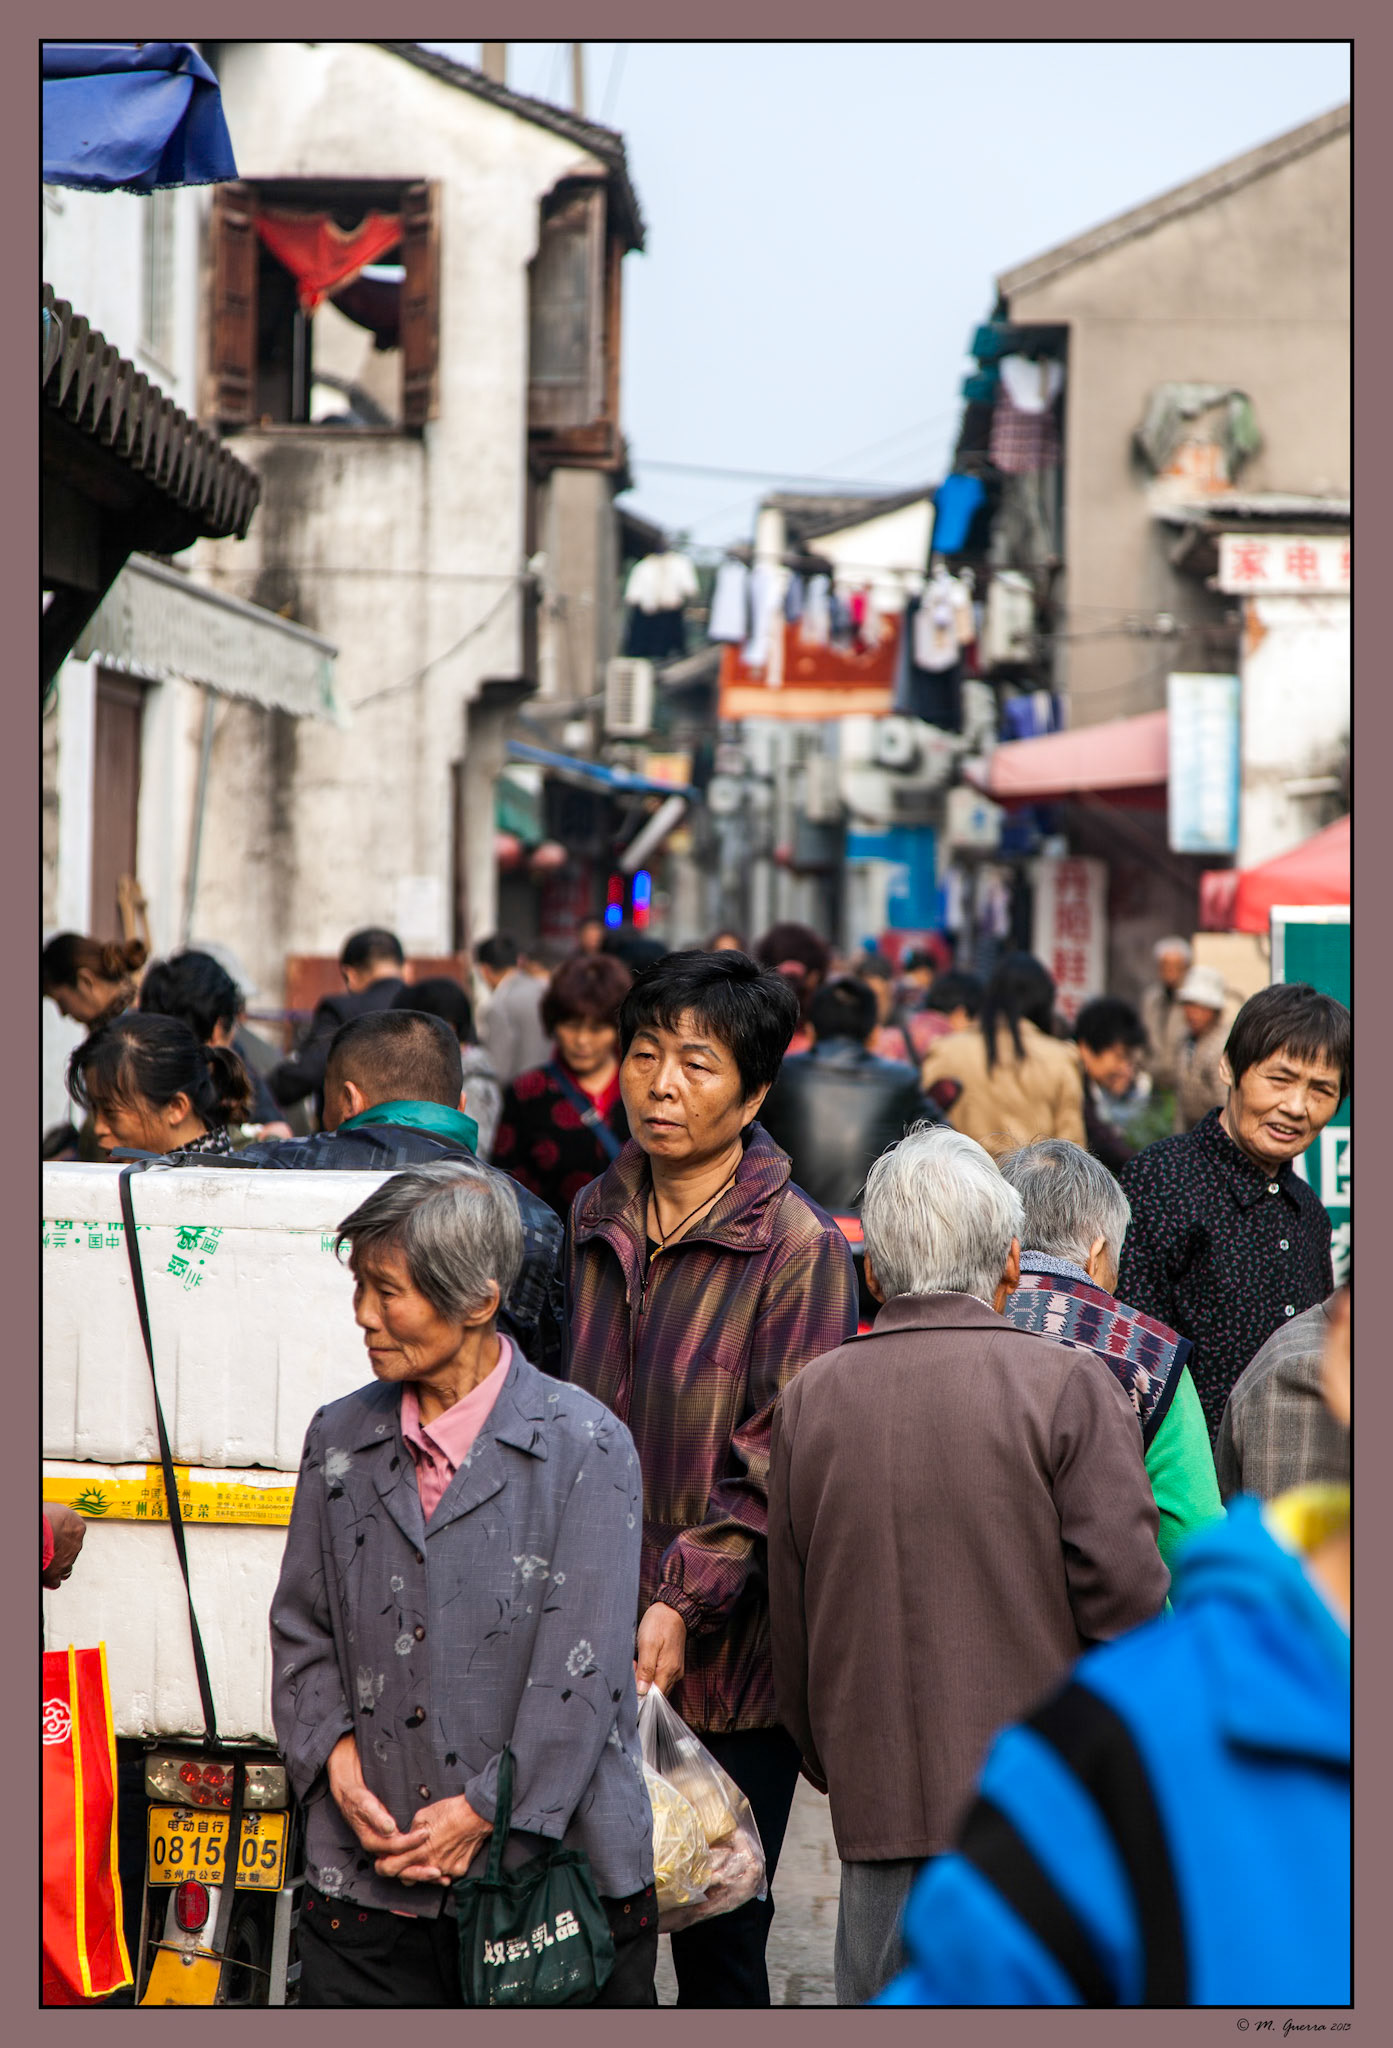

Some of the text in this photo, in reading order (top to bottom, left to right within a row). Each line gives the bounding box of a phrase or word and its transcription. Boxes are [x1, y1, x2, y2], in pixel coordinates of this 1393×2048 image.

[1231, 540, 1349, 582] 家电
[184, 1227, 223, 1291] 中国·兰
[121, 1501, 209, 1518] 兰州高夏菜
[168, 1820, 225, 1833] 电动自行
[154, 1836, 277, 1869] 081505
[164, 1869, 259, 1882] 苏州市公安监制
